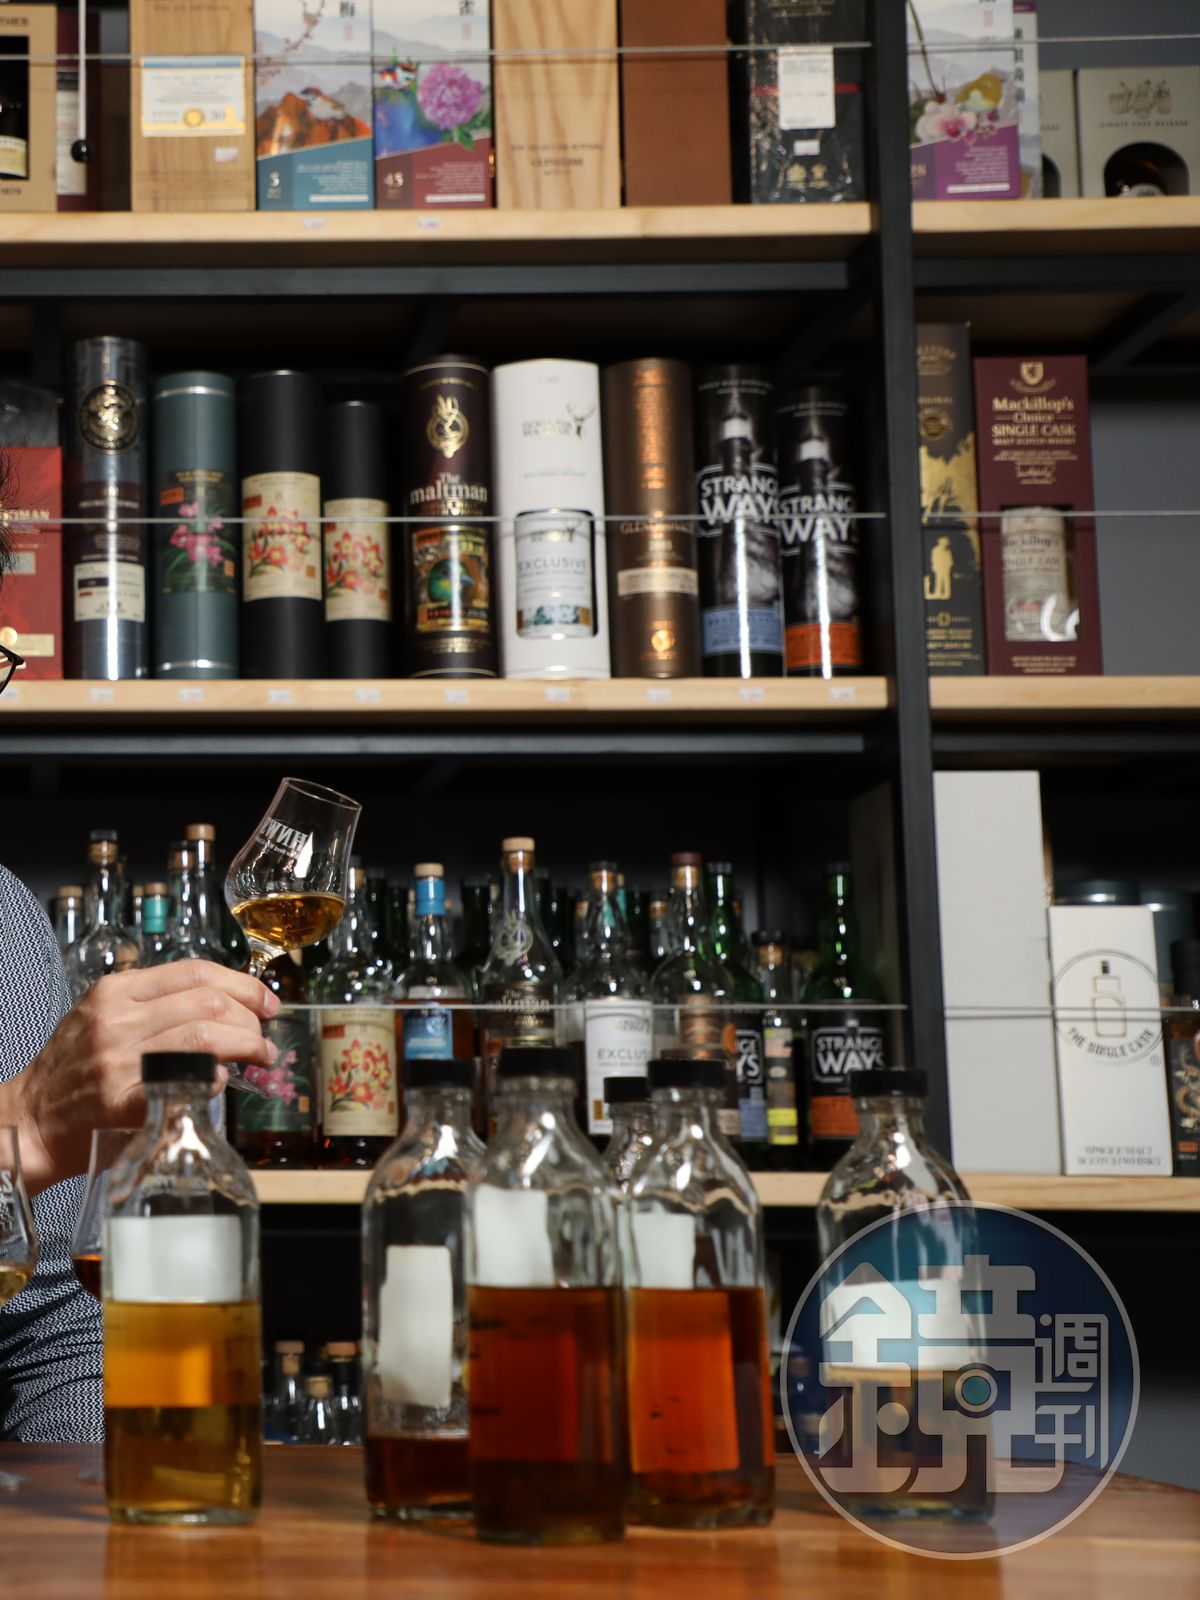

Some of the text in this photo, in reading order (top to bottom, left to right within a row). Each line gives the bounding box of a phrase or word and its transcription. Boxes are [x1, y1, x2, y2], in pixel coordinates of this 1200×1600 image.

[991, 423, 1077, 437] SINGLE CASK
[439, 472, 460, 485] The
[410, 479, 488, 505] maltman
[781, 493, 854, 515] STRANG
[781, 514, 850, 545] WAY
[519, 558, 587, 571] EXCLUSIVE
[816, 1036, 883, 1051] STRANG
[597, 1048, 648, 1061] EXCLUS
